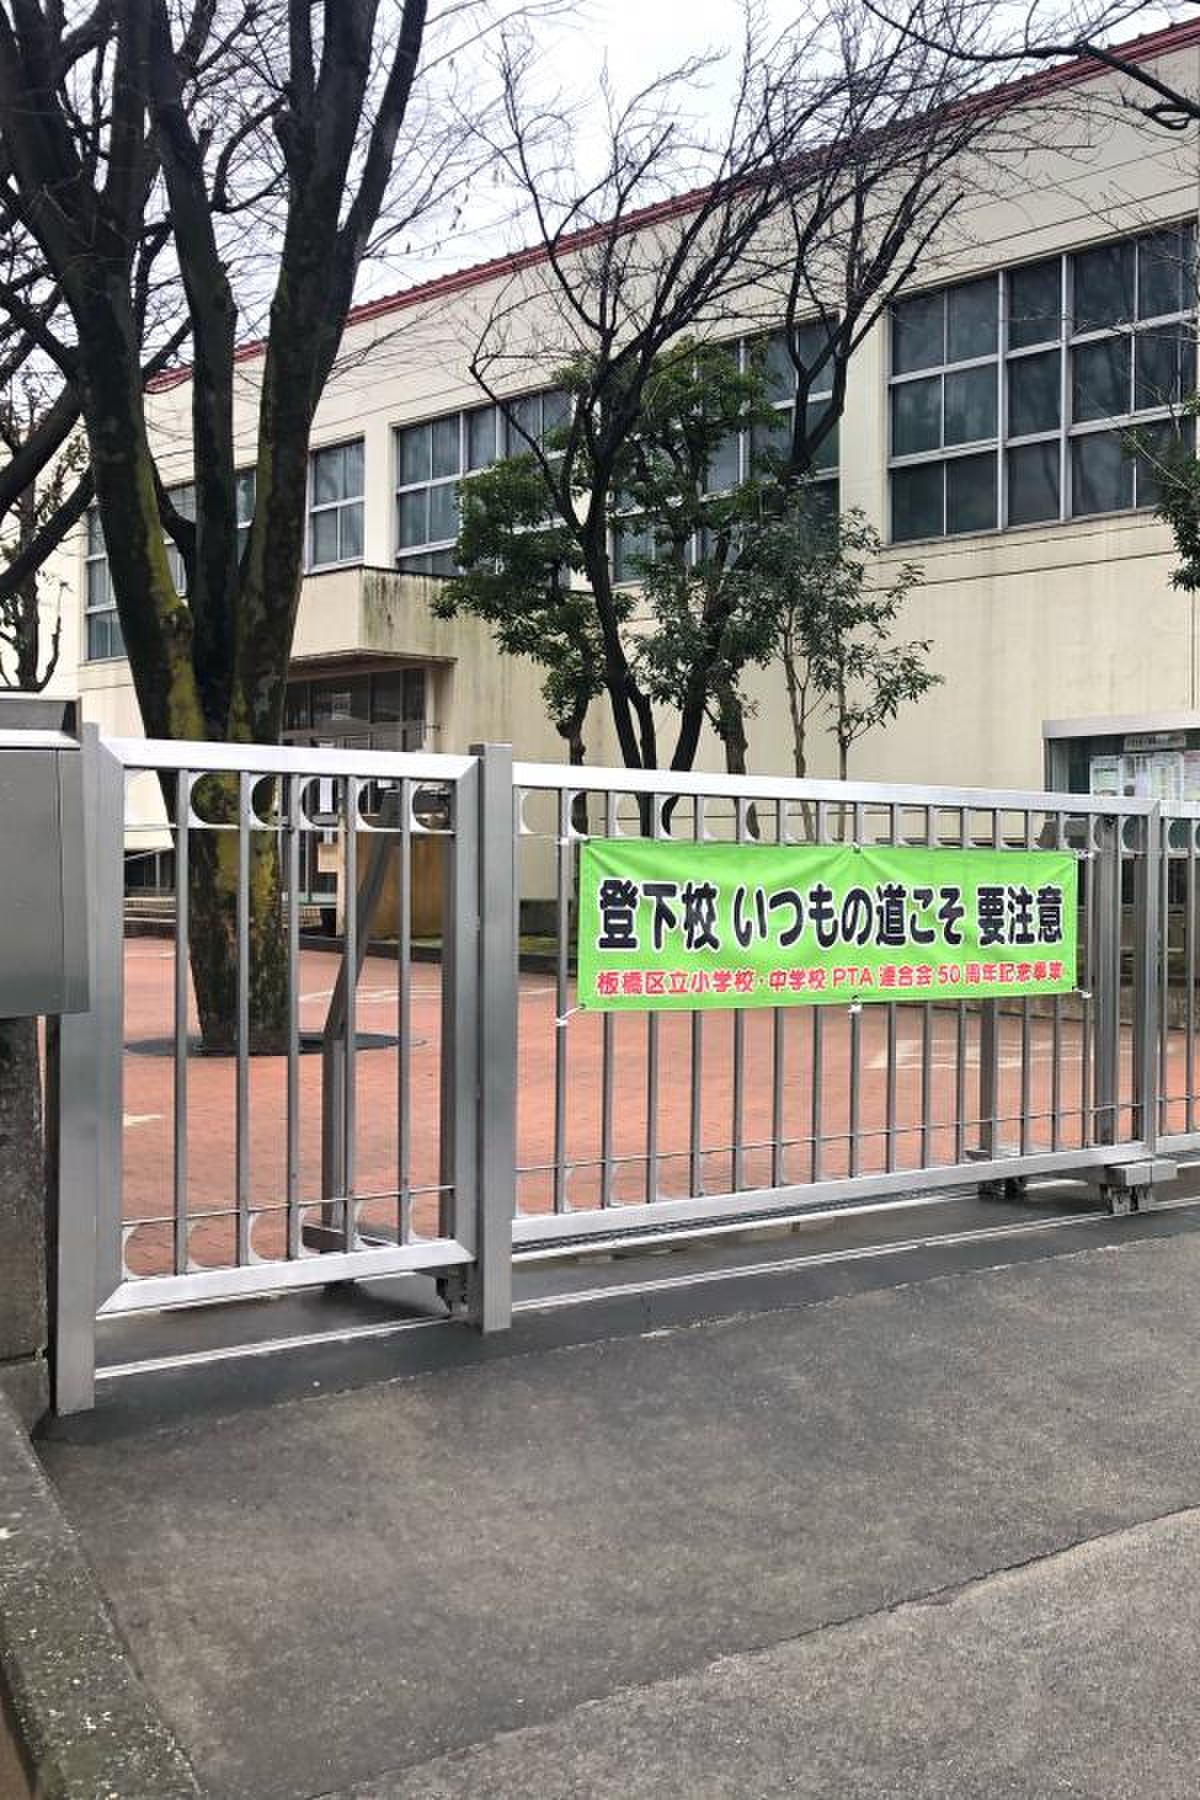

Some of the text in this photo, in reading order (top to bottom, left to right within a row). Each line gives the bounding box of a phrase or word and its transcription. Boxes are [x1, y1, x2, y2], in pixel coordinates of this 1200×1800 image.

[598, 878, 1064, 950] 登下校 いつもの道こそ 要注意
[832, 966, 874, 987] PTA
[879, 964, 933, 987] 連合会
[937, 963, 961, 984] 50
[964, 960, 1063, 985] 周年記念事業
